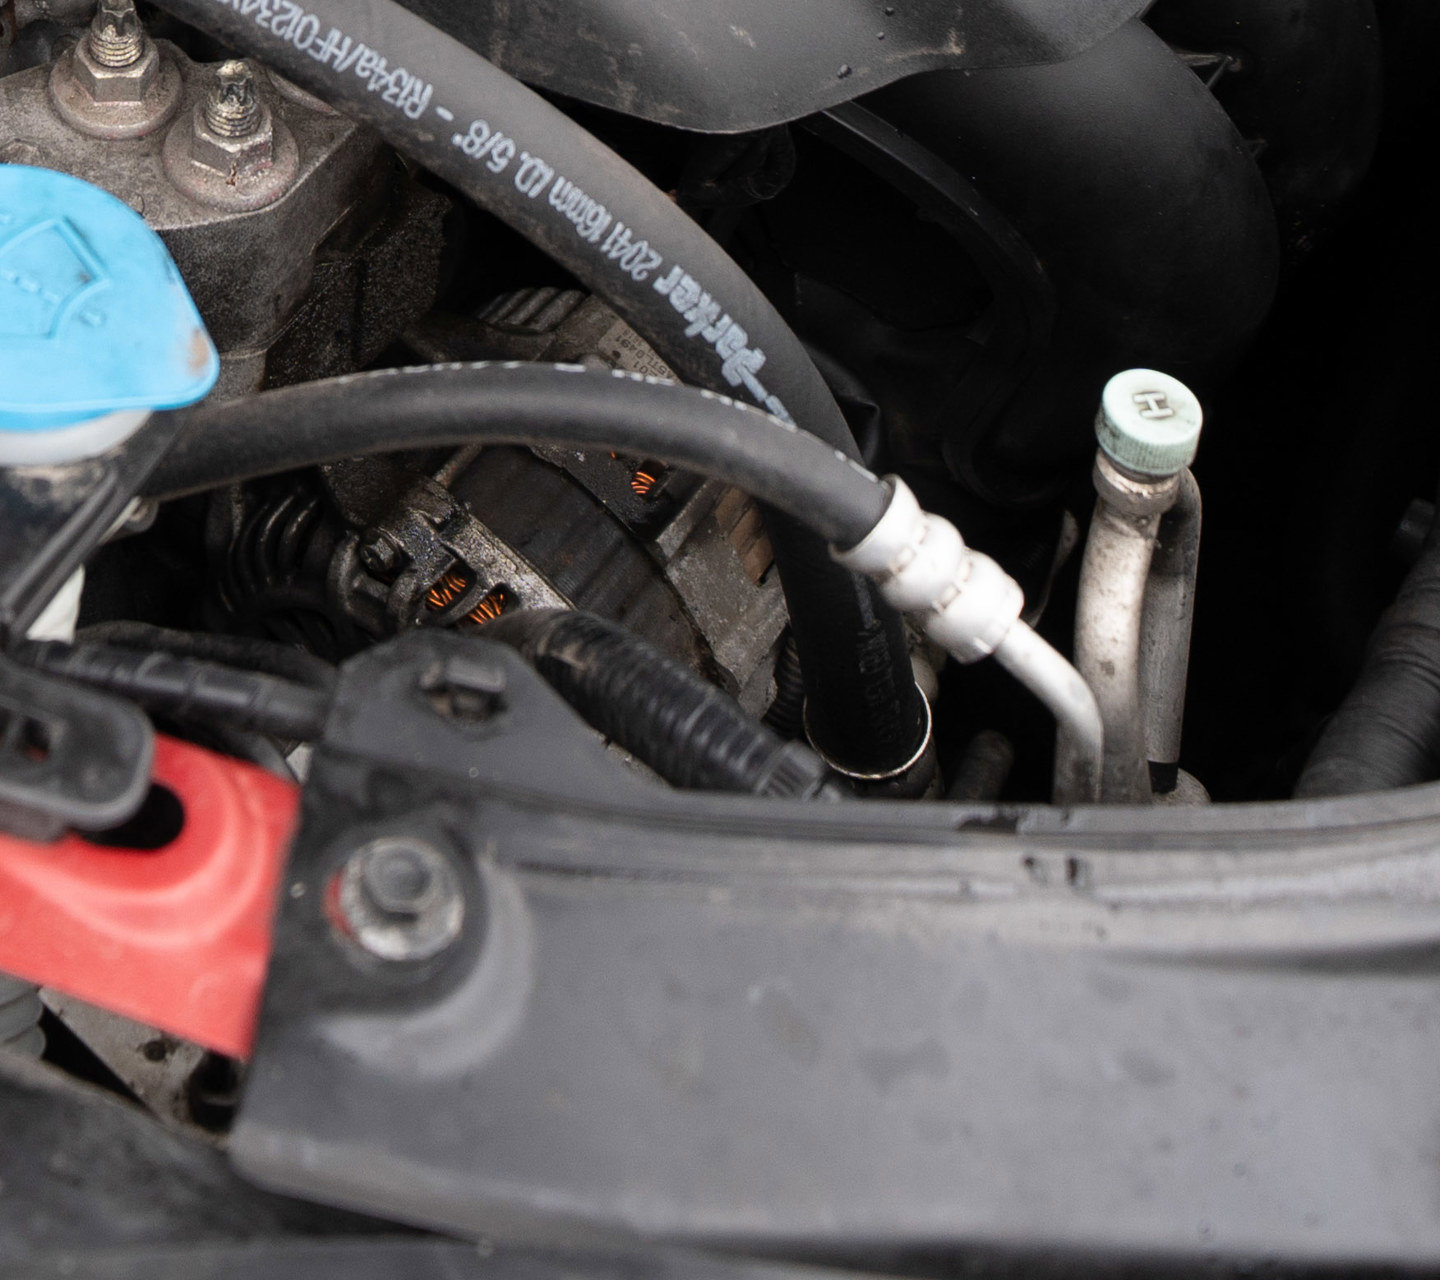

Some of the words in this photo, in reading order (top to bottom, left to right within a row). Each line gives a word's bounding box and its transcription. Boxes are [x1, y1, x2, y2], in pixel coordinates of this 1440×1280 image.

[548, 175, 612, 244] 16mm
[600, 220, 664, 282] 2041
[652, 264, 768, 387] Parker
[1132, 390, 1176, 420] H
